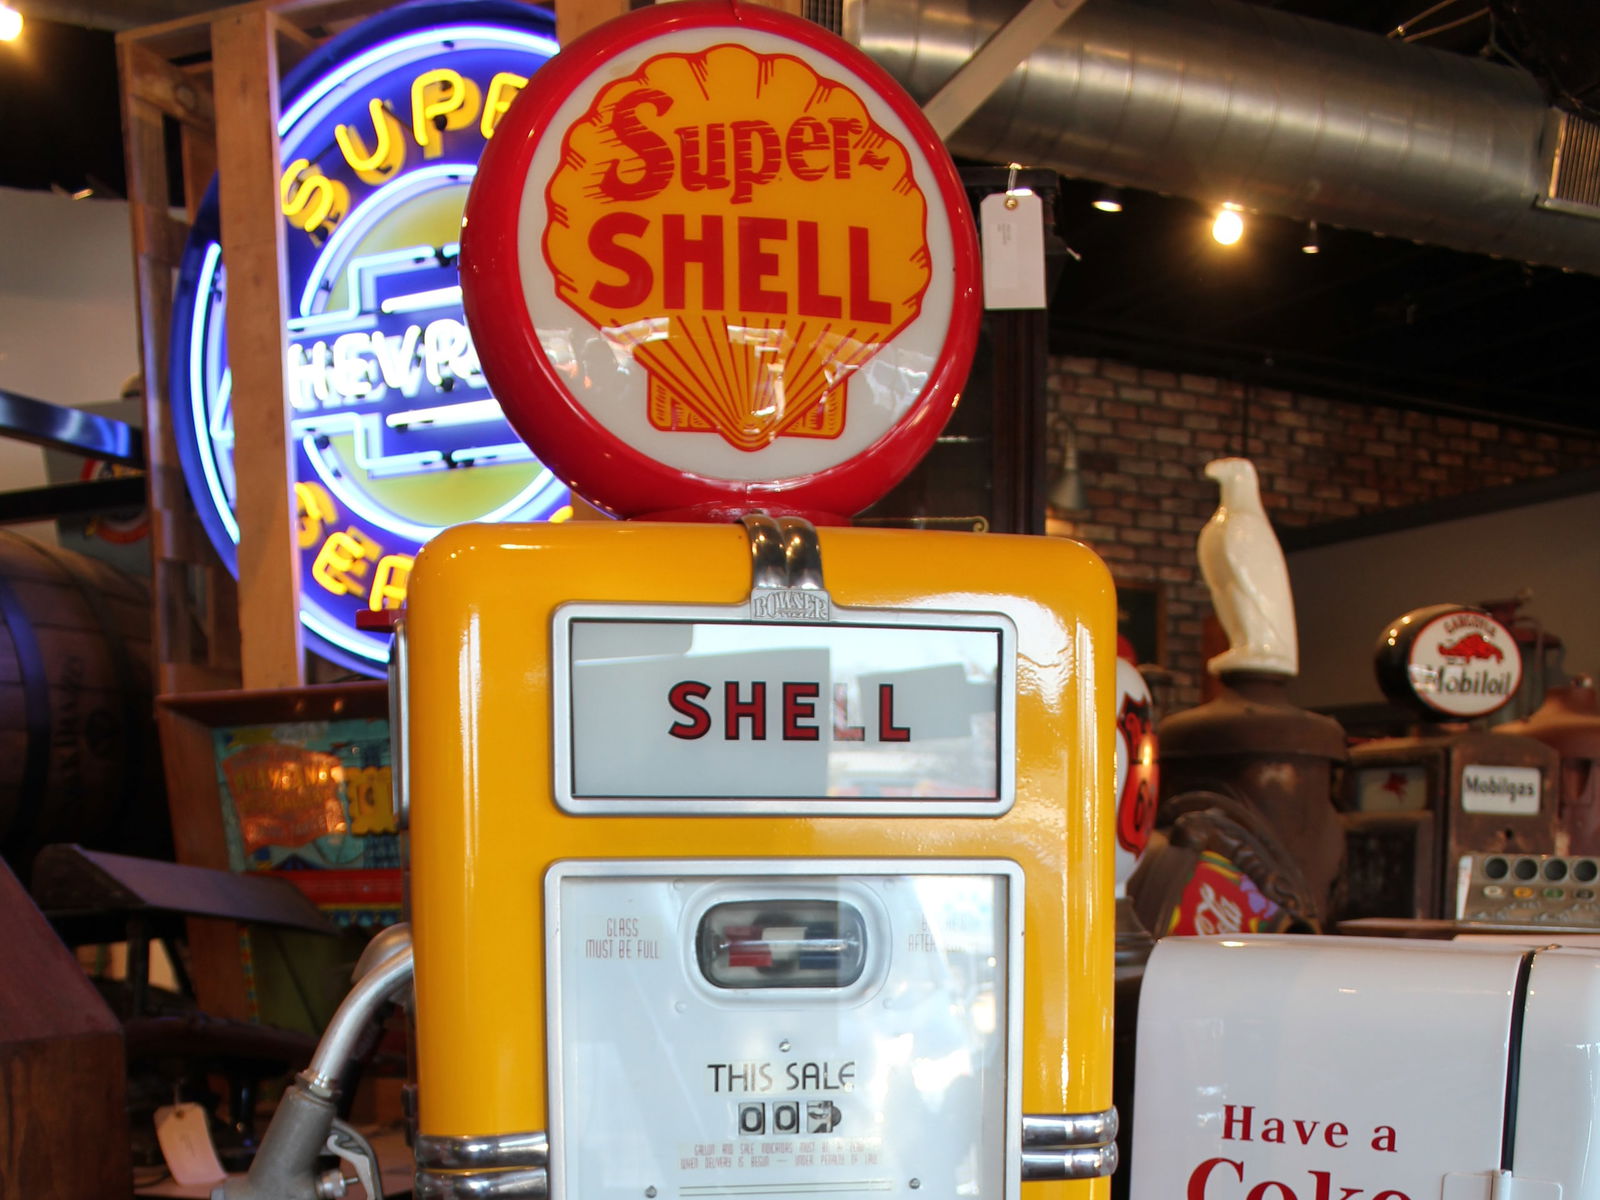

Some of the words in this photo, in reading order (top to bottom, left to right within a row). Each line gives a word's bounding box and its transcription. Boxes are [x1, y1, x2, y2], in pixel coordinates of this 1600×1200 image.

[588, 211, 892, 325] SHELL
[754, 590, 827, 619] BOWSER
[668, 680, 911, 742] SHELL
[1466, 774, 1536, 803] Mobilgas
[606, 917, 640, 937] GLASS
[585, 939, 612, 959] MUST
[618, 939, 633, 959] BE
[637, 939, 660, 960] FULL
[707, 1063, 773, 1093] THIS
[786, 1061, 856, 1092] SALE
[1221, 1104, 1349, 1148] Have
[1371, 1125, 1398, 1152] a
